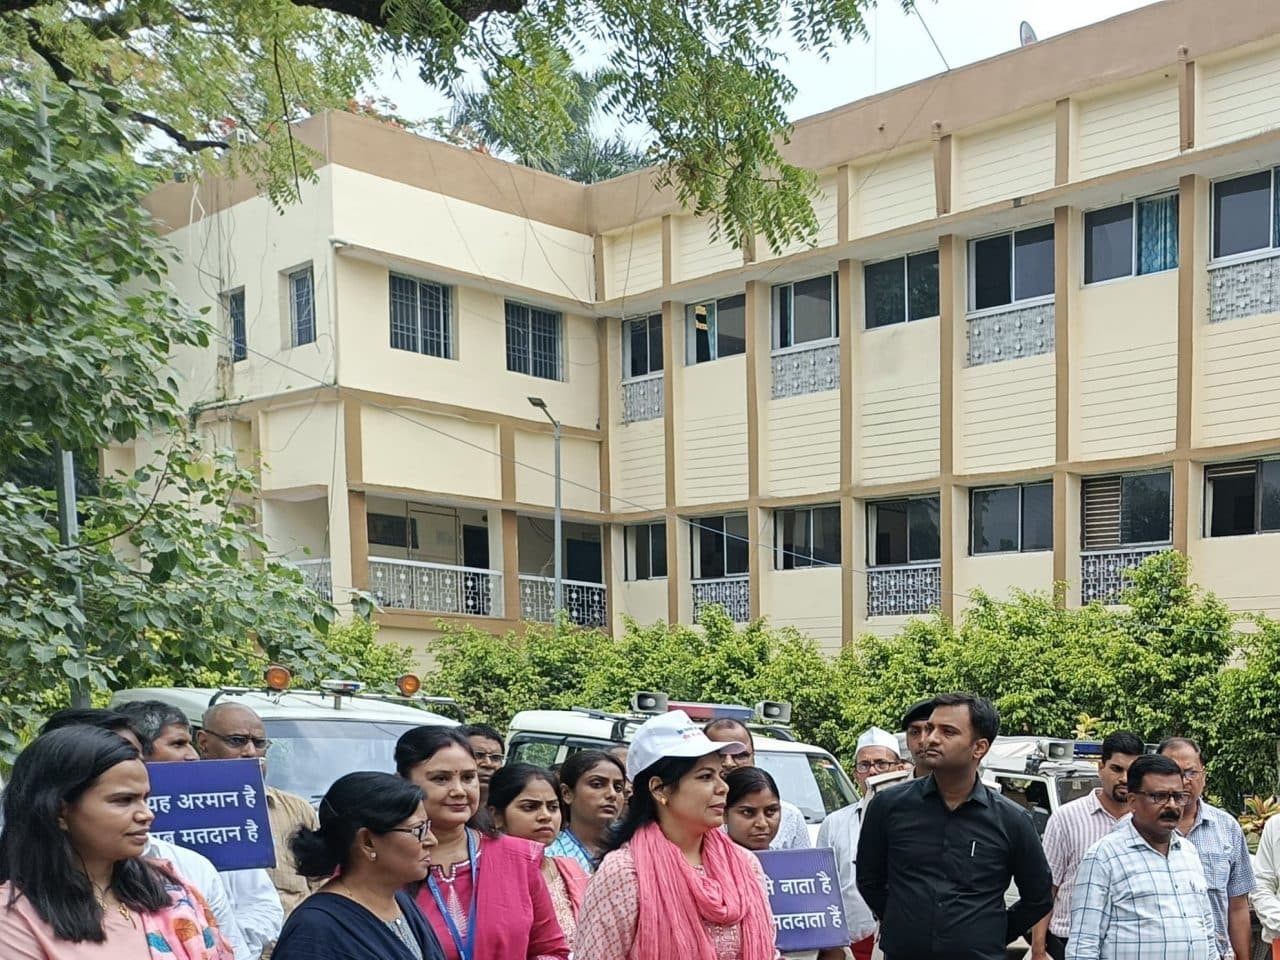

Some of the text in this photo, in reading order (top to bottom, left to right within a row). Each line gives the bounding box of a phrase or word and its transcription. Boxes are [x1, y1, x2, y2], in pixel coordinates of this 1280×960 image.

[177, 791, 239, 810] अरमान
[242, 784, 257, 808] है
[180, 826, 241, 845] मतदान
[244, 819, 259, 843] है
[779, 878, 815, 895] नाता
[816, 871, 832, 894] है
